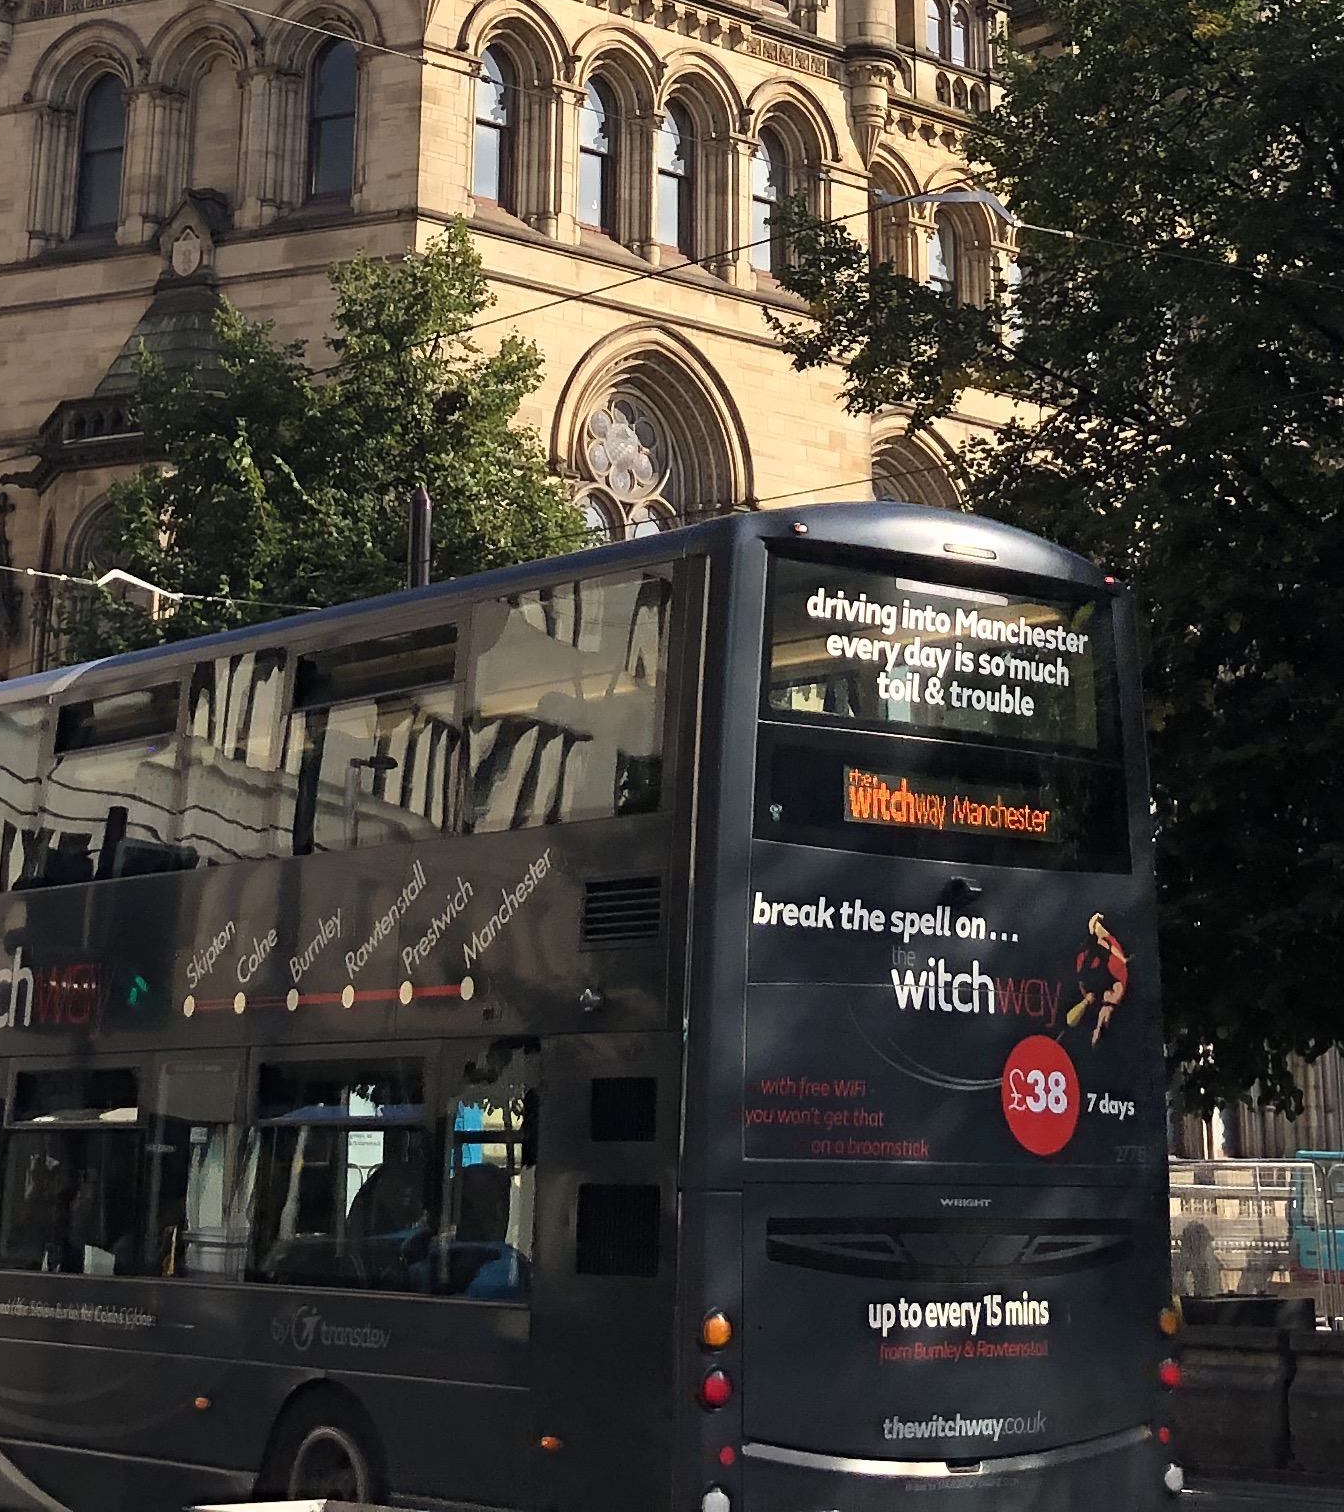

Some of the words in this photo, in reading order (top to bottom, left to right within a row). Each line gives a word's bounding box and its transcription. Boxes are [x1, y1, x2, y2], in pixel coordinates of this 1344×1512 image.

[806, 588, 898, 635] driving
[902, 599, 951, 634] into
[956, 607, 1089, 655] Manchester
[826, 634, 901, 672] every
[904, 637, 951, 678] day
[955, 643, 974, 673] is
[978, 653, 1005, 677] so
[1009, 657, 1070, 687] much
[877, 672, 921, 703] toil
[924, 676, 945, 706] &
[949, 681, 1035, 717] trouble
[953, 793, 1050, 832] Manchester
[344, 859, 427, 979] Rawtenstall
[402, 876, 474, 975] Prestwich
[462, 848, 553, 969] Manchester
[752, 892, 835, 929] break
[840, 899, 885, 931] the
[890, 905, 951, 943] spell
[186, 920, 236, 989] Skipton
[236, 927, 278, 984] Colne
[289, 907, 343, 983] Burnley
[891, 945, 916, 967] the
[890, 956, 1062, 1027] witchway
[761, 1076, 796, 1095] with
[799, 1076, 829, 1100] free
[1009, 1069, 1068, 1114] £38
[1087, 1092, 1097, 1113] 7
[1099, 1092, 1135, 1121] days
[745, 1108, 773, 1128] you
[824, 1108, 849, 1130] get
[853, 1107, 884, 1128] that
[811, 1139, 831, 1155] on
[835, 1140, 846, 1155] a
[849, 1137, 928, 1158] broomstick
[940, 1198, 992, 1207] WRIGHT
[321, 1321, 393, 1348] transdev
[868, 1302, 896, 1337] up
[899, 1297, 922, 1328] to
[925, 1301, 981, 1336] every
[984, 1294, 1002, 1326] 15
[1005, 1290, 1050, 1326] mins
[880, 1342, 912, 1364] from
[914, 1341, 962, 1362] Burnley
[963, 1340, 975, 1358] &
[883, 1410, 1048, 1441] thewitchway.co.uk
